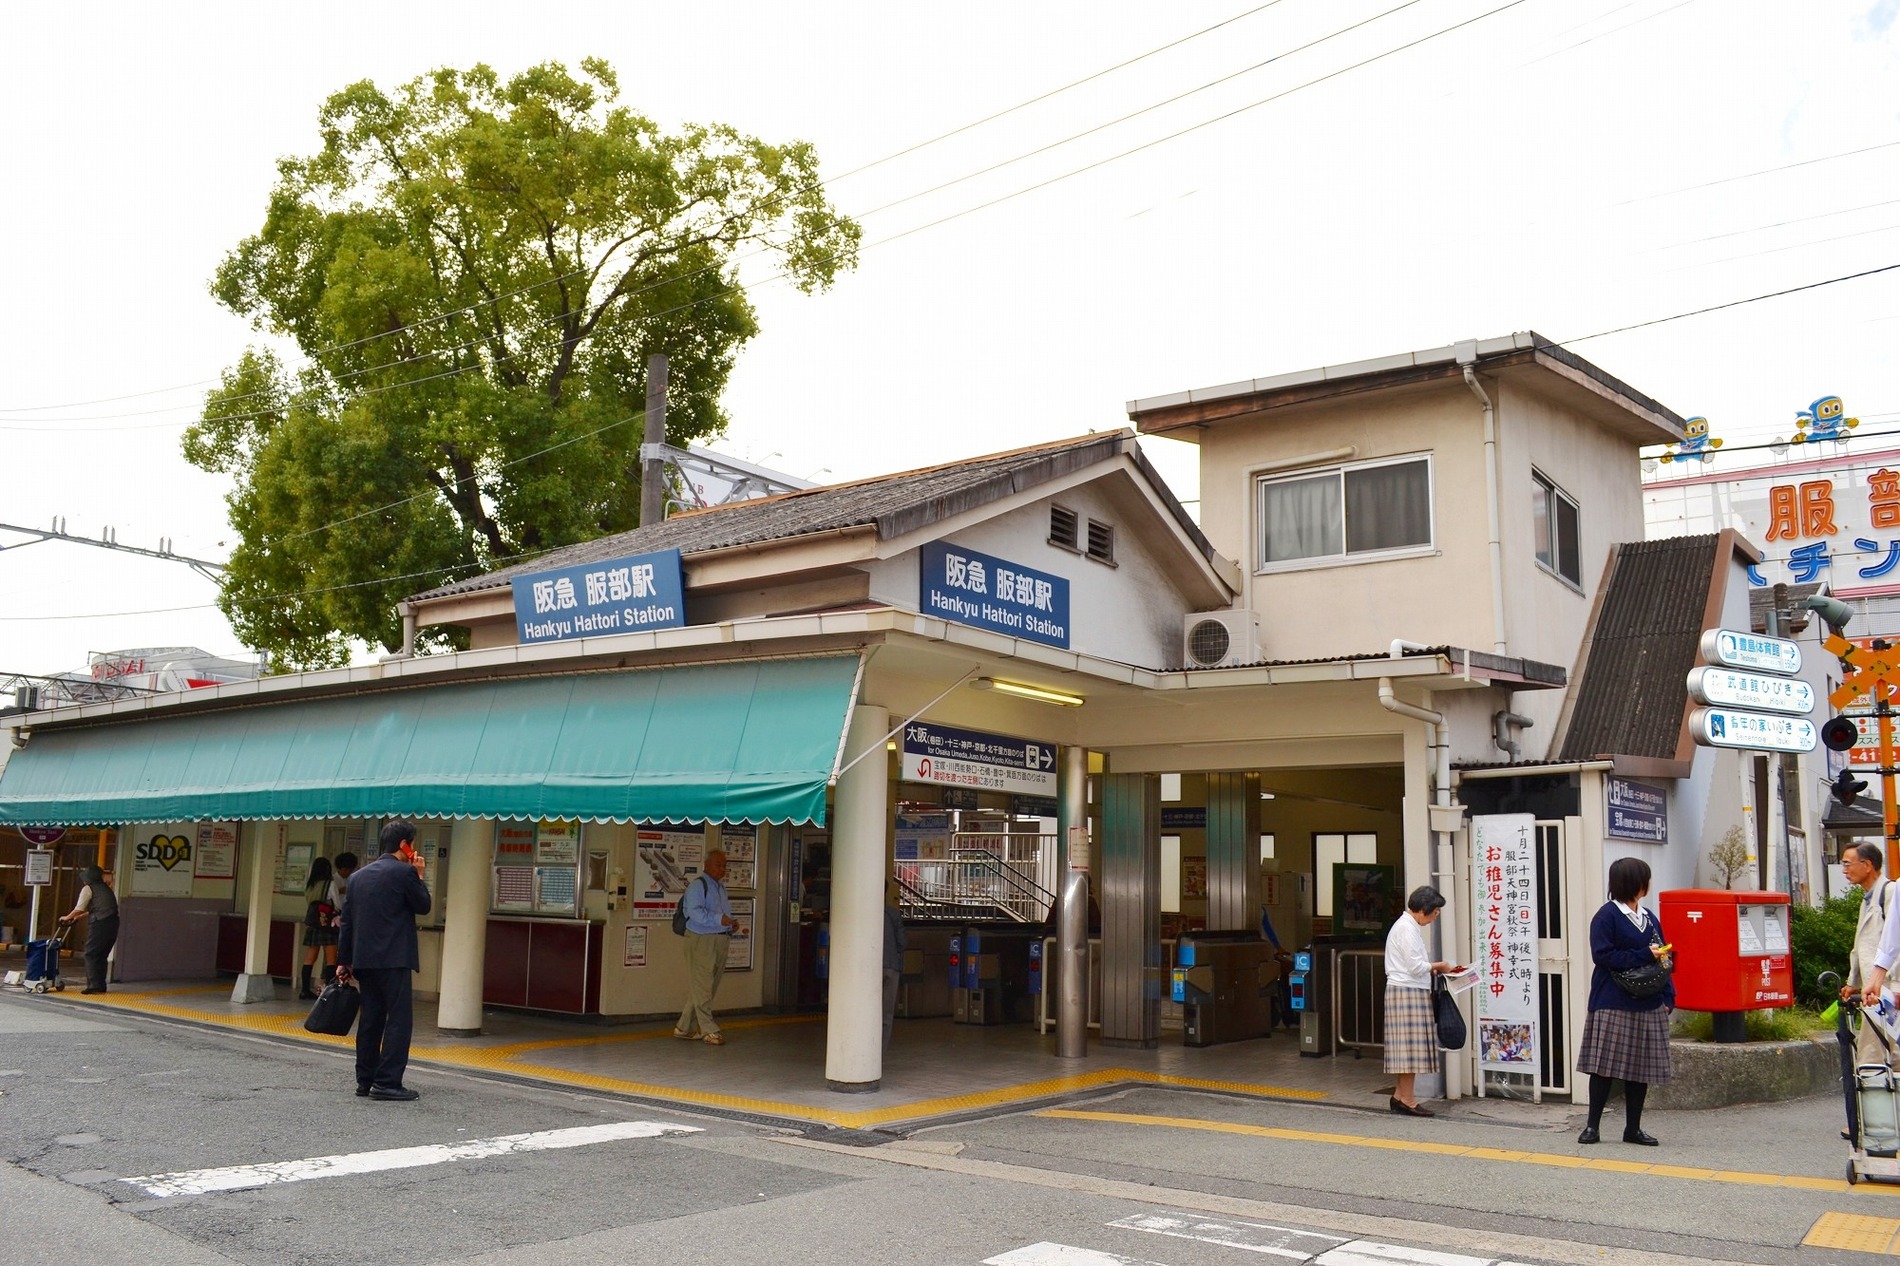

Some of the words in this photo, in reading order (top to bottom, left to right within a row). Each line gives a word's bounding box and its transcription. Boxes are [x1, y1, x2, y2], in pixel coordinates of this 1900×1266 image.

[533, 577, 578, 614] 阪急
[585, 563, 657, 606] 服部駅
[945, 553, 988, 594] 阪急
[996, 567, 1053, 613] 服部駅
[524, 619, 572, 639] Hankyu
[574, 610, 620, 632] Hattori
[624, 604, 675, 626] Station
[931, 589, 979, 618] Hankyu
[982, 602, 1022, 628] Hattori
[1025, 614, 1064, 639] Station
[1485, 845, 1505, 998] お稚児さん募集中
[1297, 956, 1307, 966] IC
